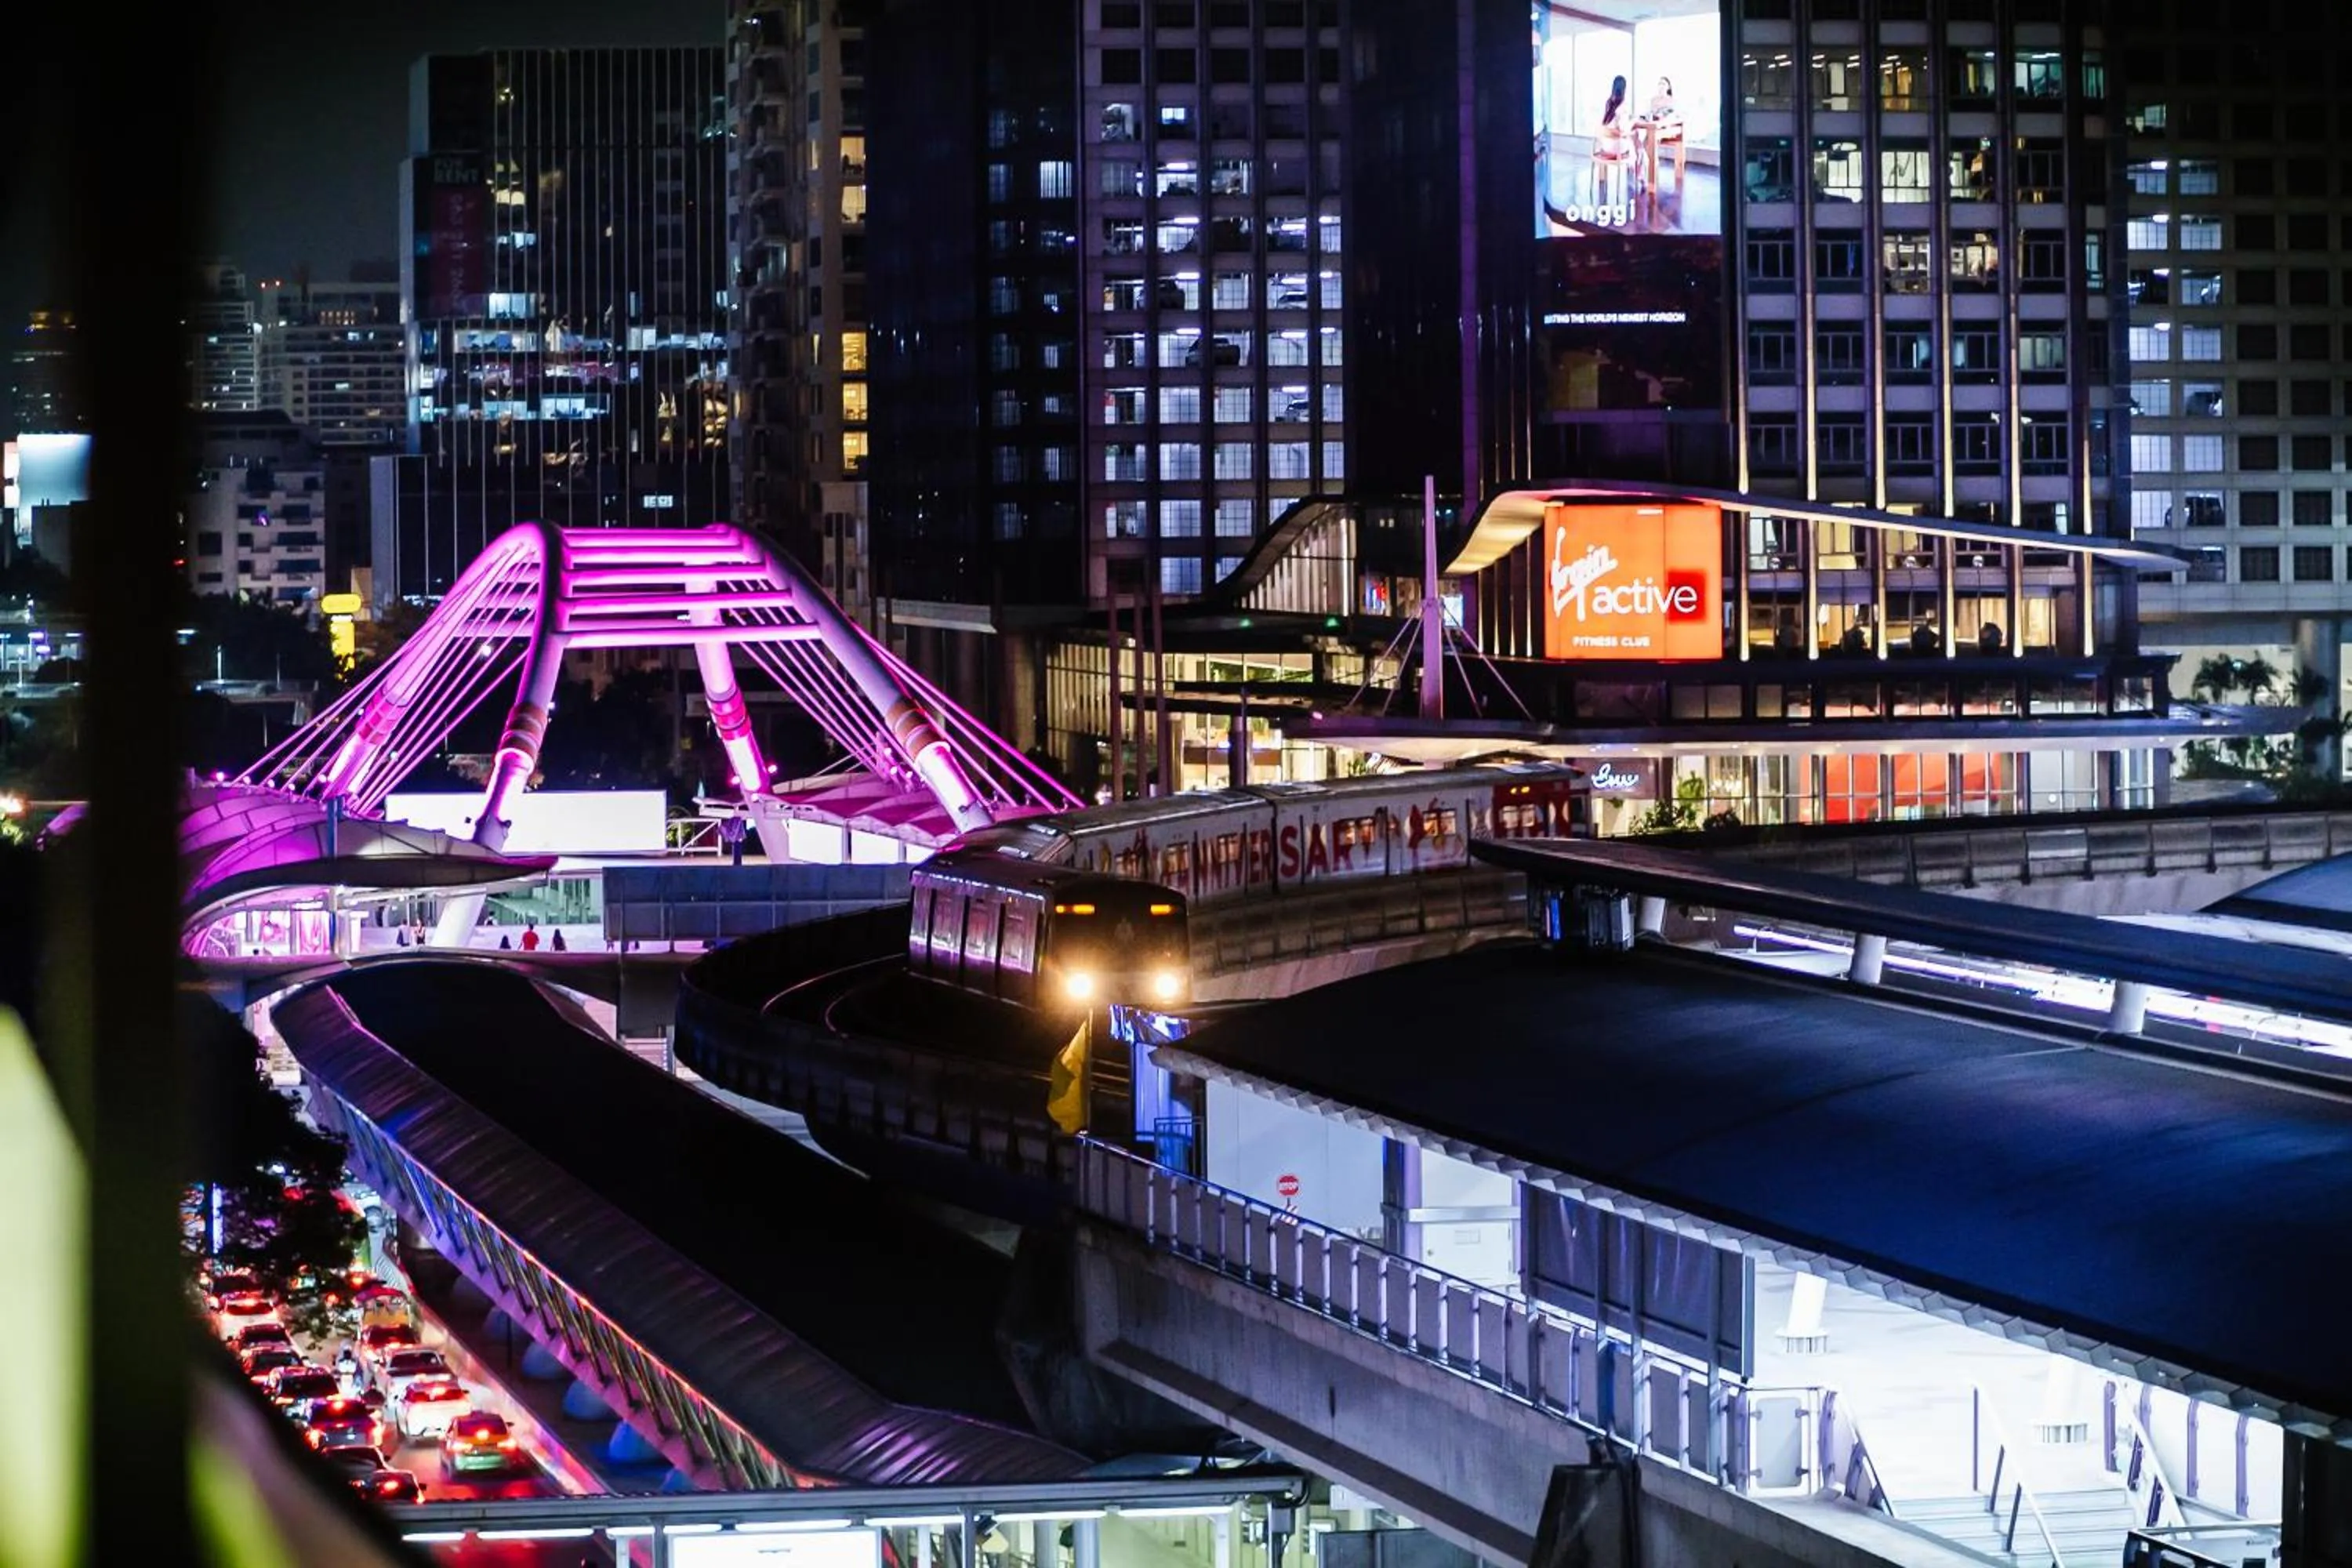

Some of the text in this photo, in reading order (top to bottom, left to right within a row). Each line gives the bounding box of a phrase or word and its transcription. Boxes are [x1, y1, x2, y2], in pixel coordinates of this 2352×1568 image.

[1566, 198, 1635, 227] onggi
[1592, 577, 1697, 614] active
[1572, 636, 1650, 647] FITNESS CLUB
